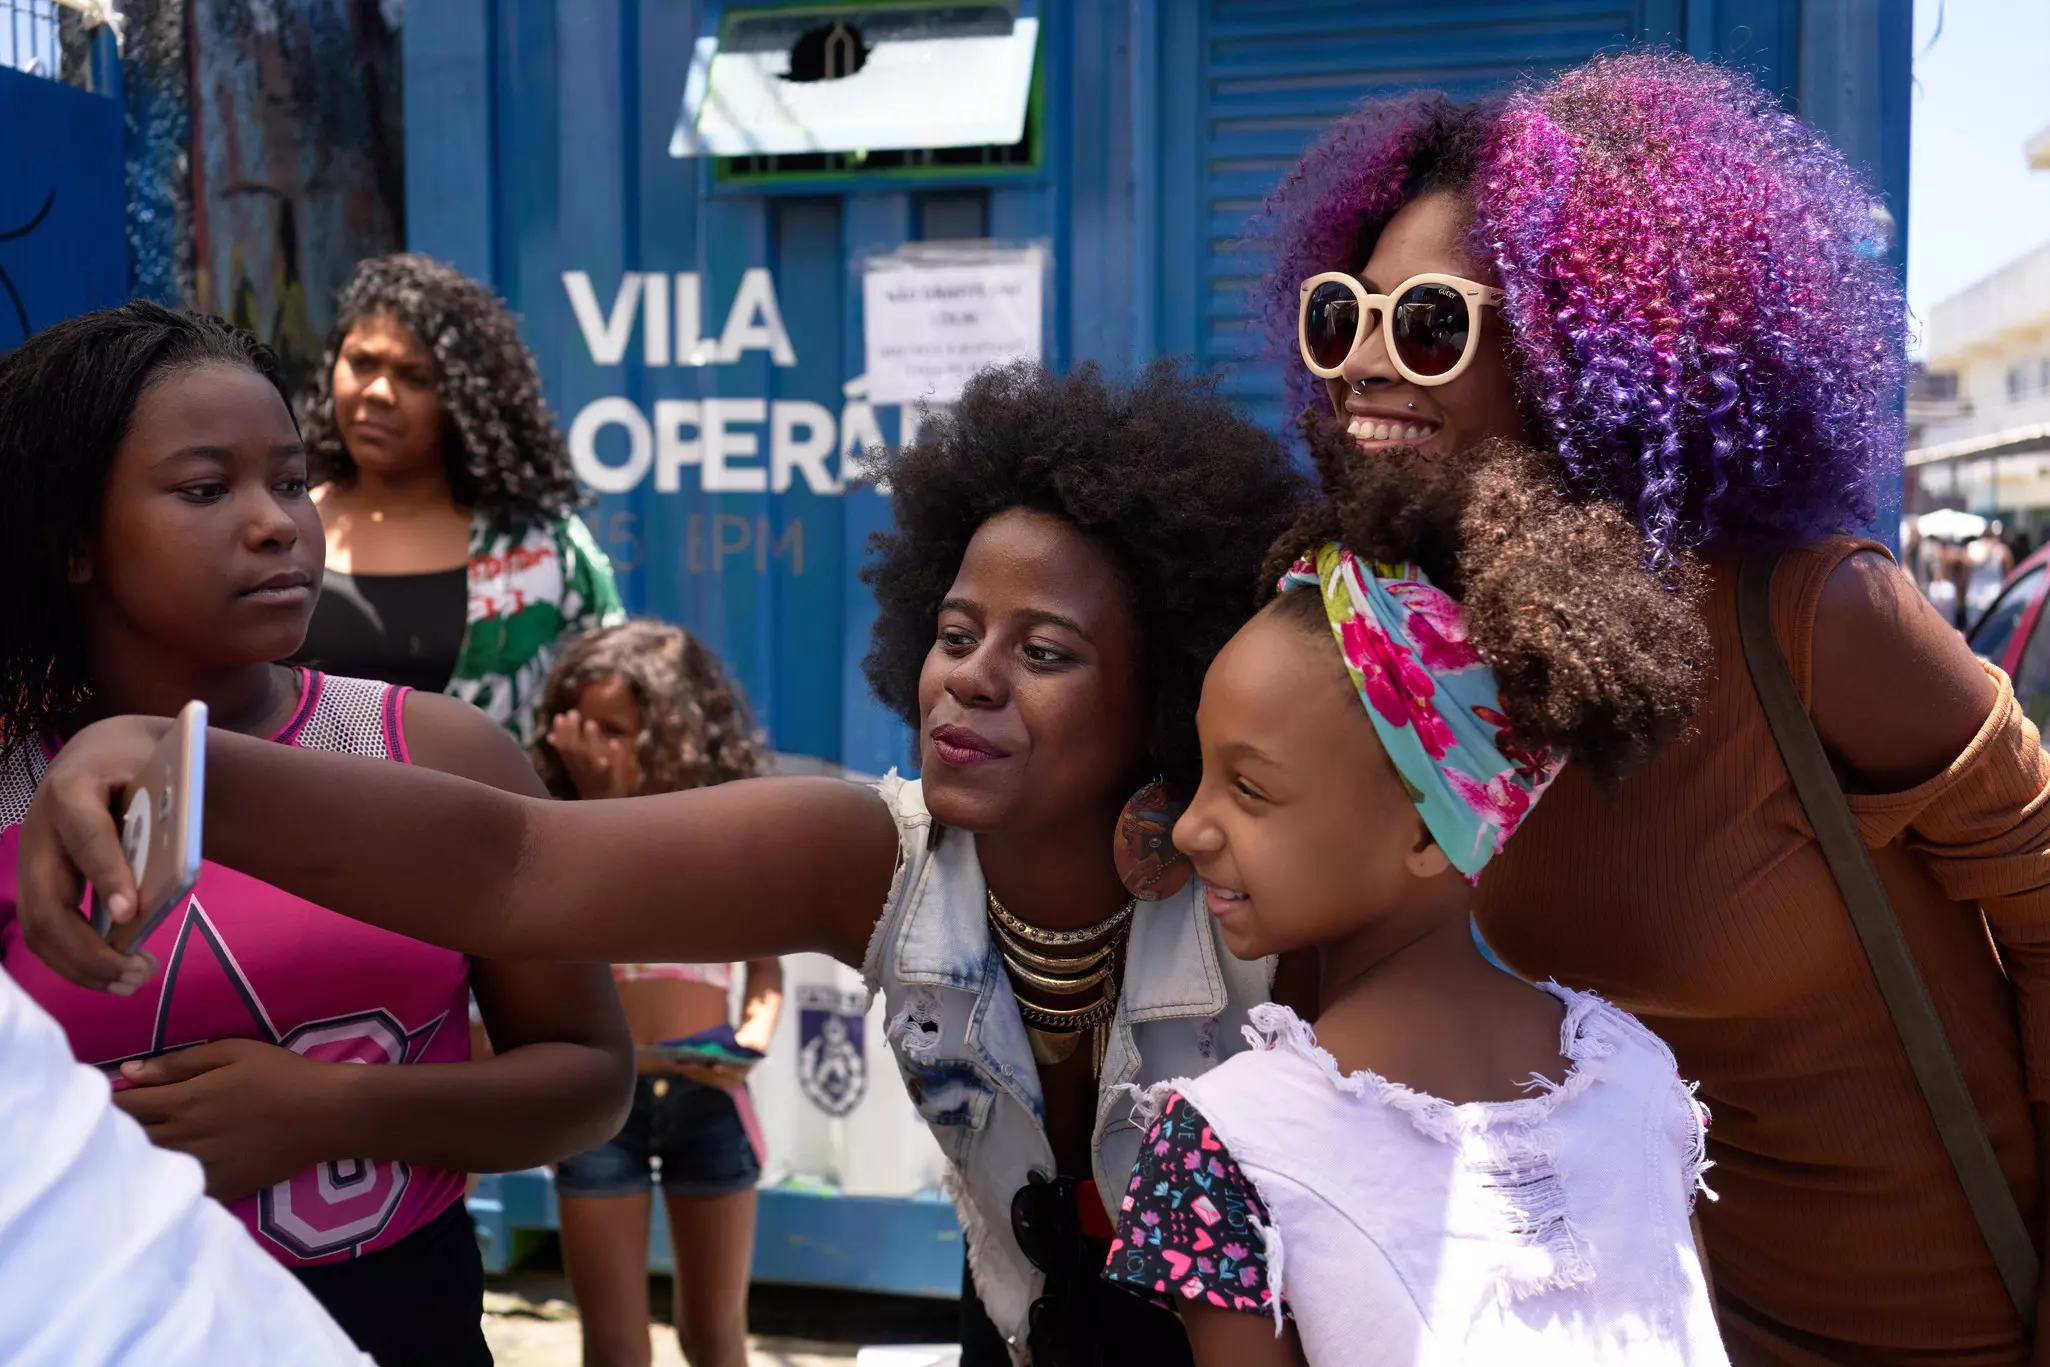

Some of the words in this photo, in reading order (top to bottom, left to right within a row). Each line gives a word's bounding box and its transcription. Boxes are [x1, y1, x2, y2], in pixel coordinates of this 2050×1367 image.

[562, 267, 797, 366] VILA
[1177, 1099, 1198, 1140] OVE
[1225, 1188, 1249, 1236] LOVE
[1127, 1249, 1146, 1285] LOV
